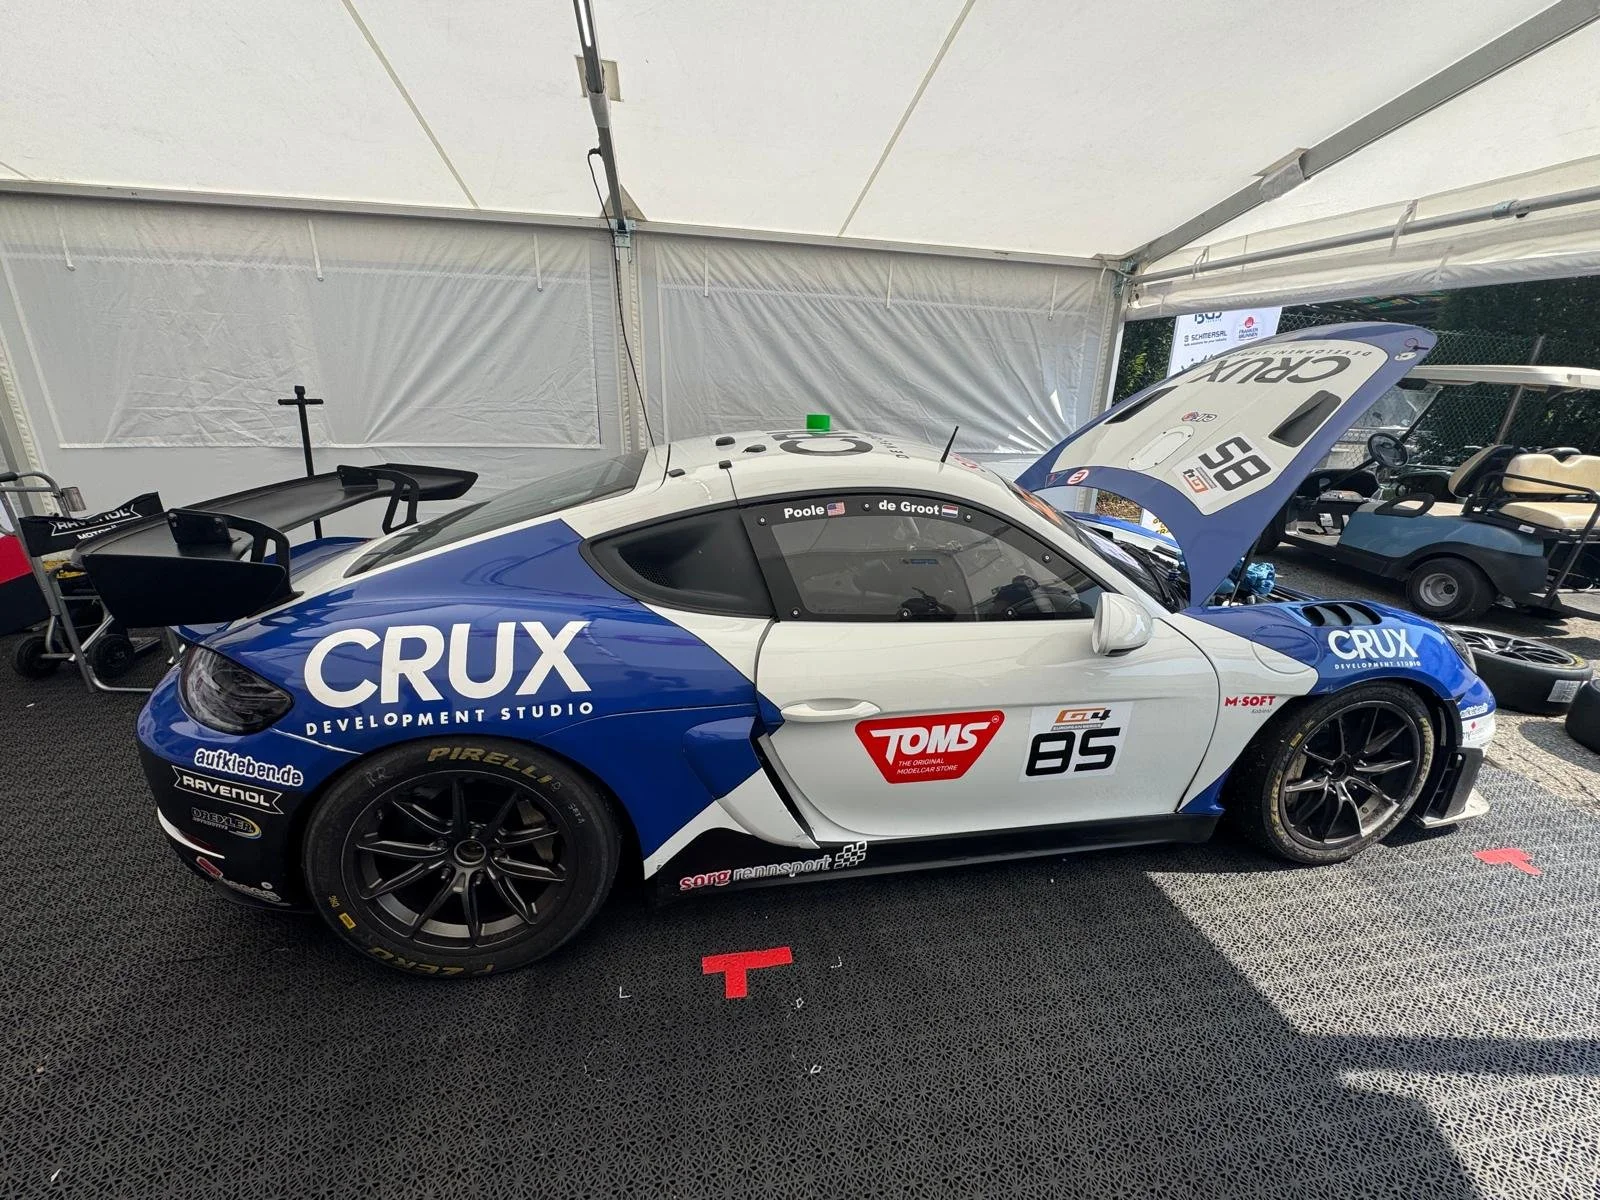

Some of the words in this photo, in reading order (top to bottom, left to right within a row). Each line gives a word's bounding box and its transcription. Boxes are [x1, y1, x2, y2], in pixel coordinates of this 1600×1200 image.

[1191, 331, 1228, 341] SCHMERSAL
[1187, 355, 1352, 384] CRUX
[1198, 436, 1272, 491] 85
[783, 504, 825, 519] Poole
[878, 500, 897, 511] de
[900, 502, 940, 516] Groot
[1327, 628, 1419, 660] CRUX
[304, 620, 593, 708] CRUX
[1334, 661, 1394, 670] DEVELOPMENT
[1396, 660, 1421, 668] STUDIO
[305, 709, 485, 736] DEVELOPMENT
[501, 702, 593, 720] STUDIO
[869, 721, 990, 766] TOMS
[1025, 727, 1121, 777] 85
[194, 748, 304, 787] aufkleben.de
[427, 747, 553, 784] PIRELLI
[897, 766, 936, 775] MODELCAR
[936, 764, 958, 773] STORE
[898, 759, 911, 767] THE
[912, 757, 944, 766] ORIGINAL
[182, 775, 271, 807] RAVENOL
[191, 806, 254, 833] DREXLER
[679, 869, 732, 891] sorg
[732, 854, 833, 881] rennsport
